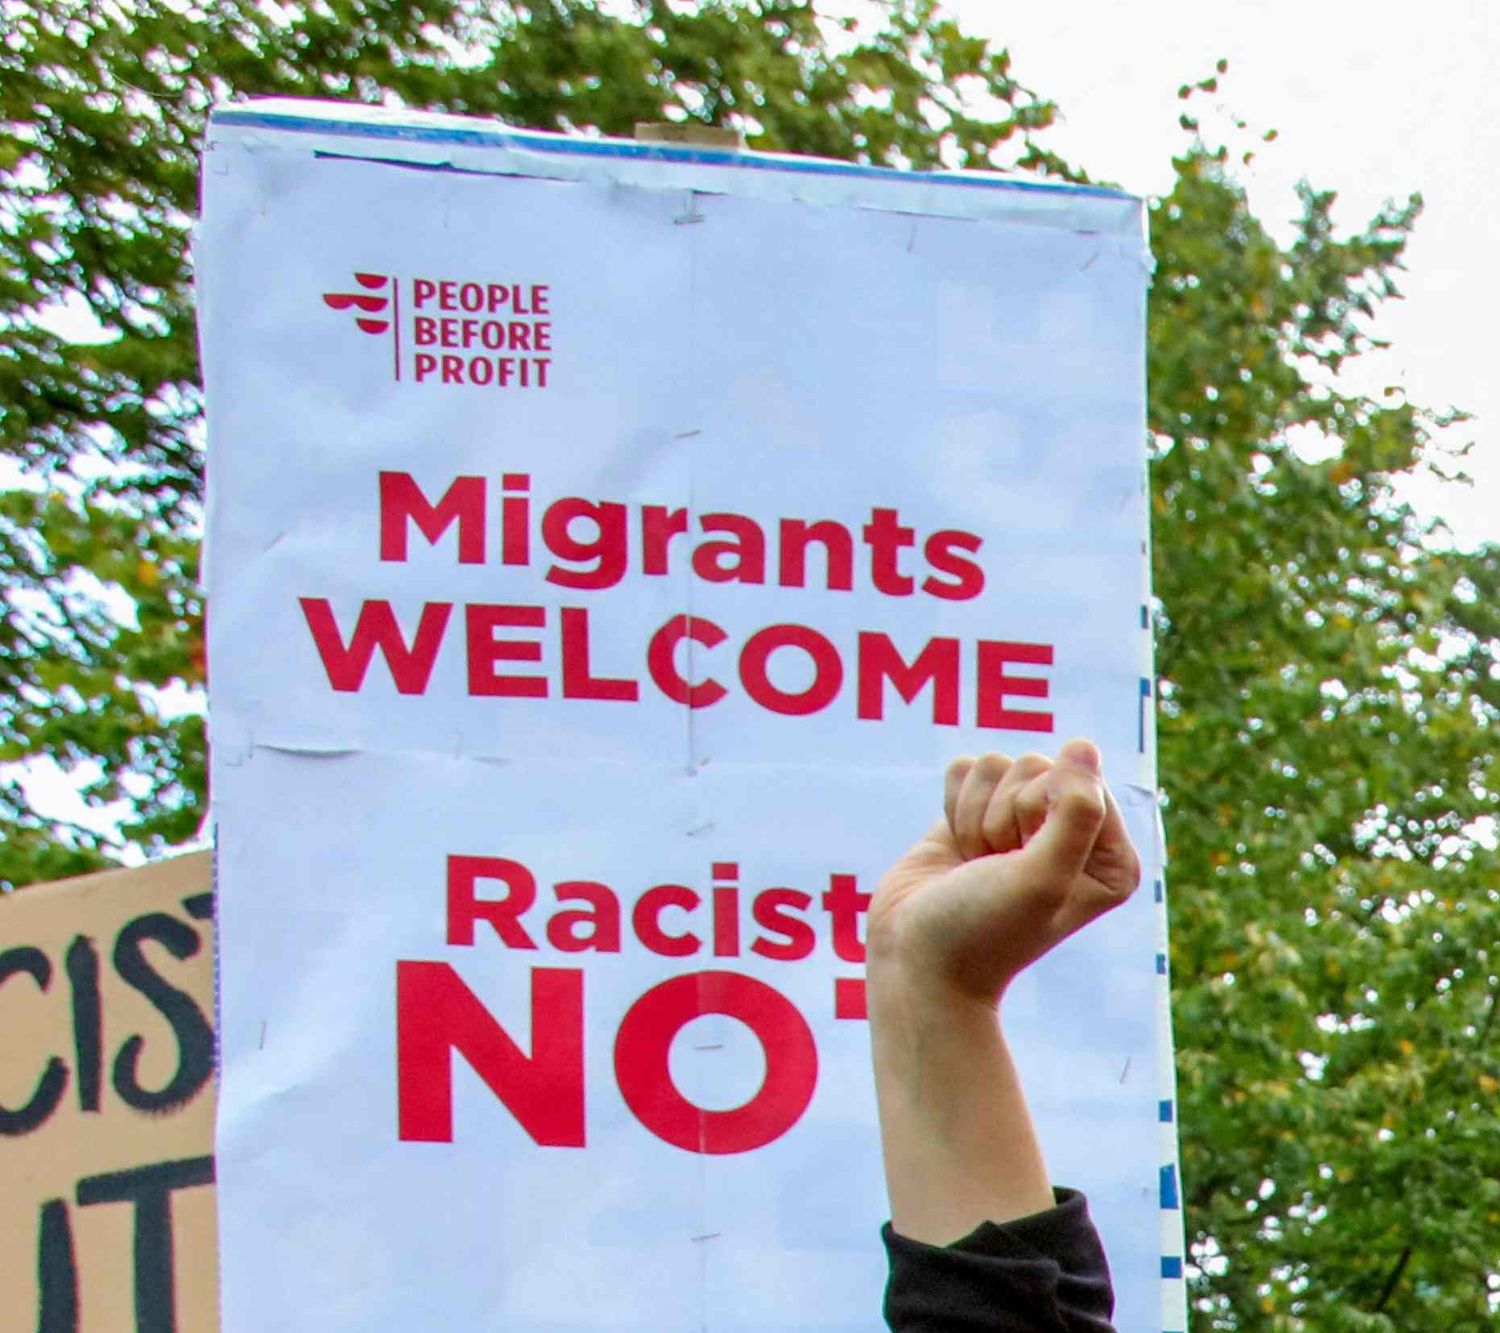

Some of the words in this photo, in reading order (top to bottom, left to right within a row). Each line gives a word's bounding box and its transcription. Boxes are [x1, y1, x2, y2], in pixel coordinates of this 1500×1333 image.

[413, 280, 550, 315] PEOPLE
[413, 315, 552, 352] BEFORE
[413, 352, 551, 388] PROFIT
[378, 471, 985, 600] Migrants
[300, 596, 1054, 733] WELCOME
[395, 958, 867, 1156] NO
